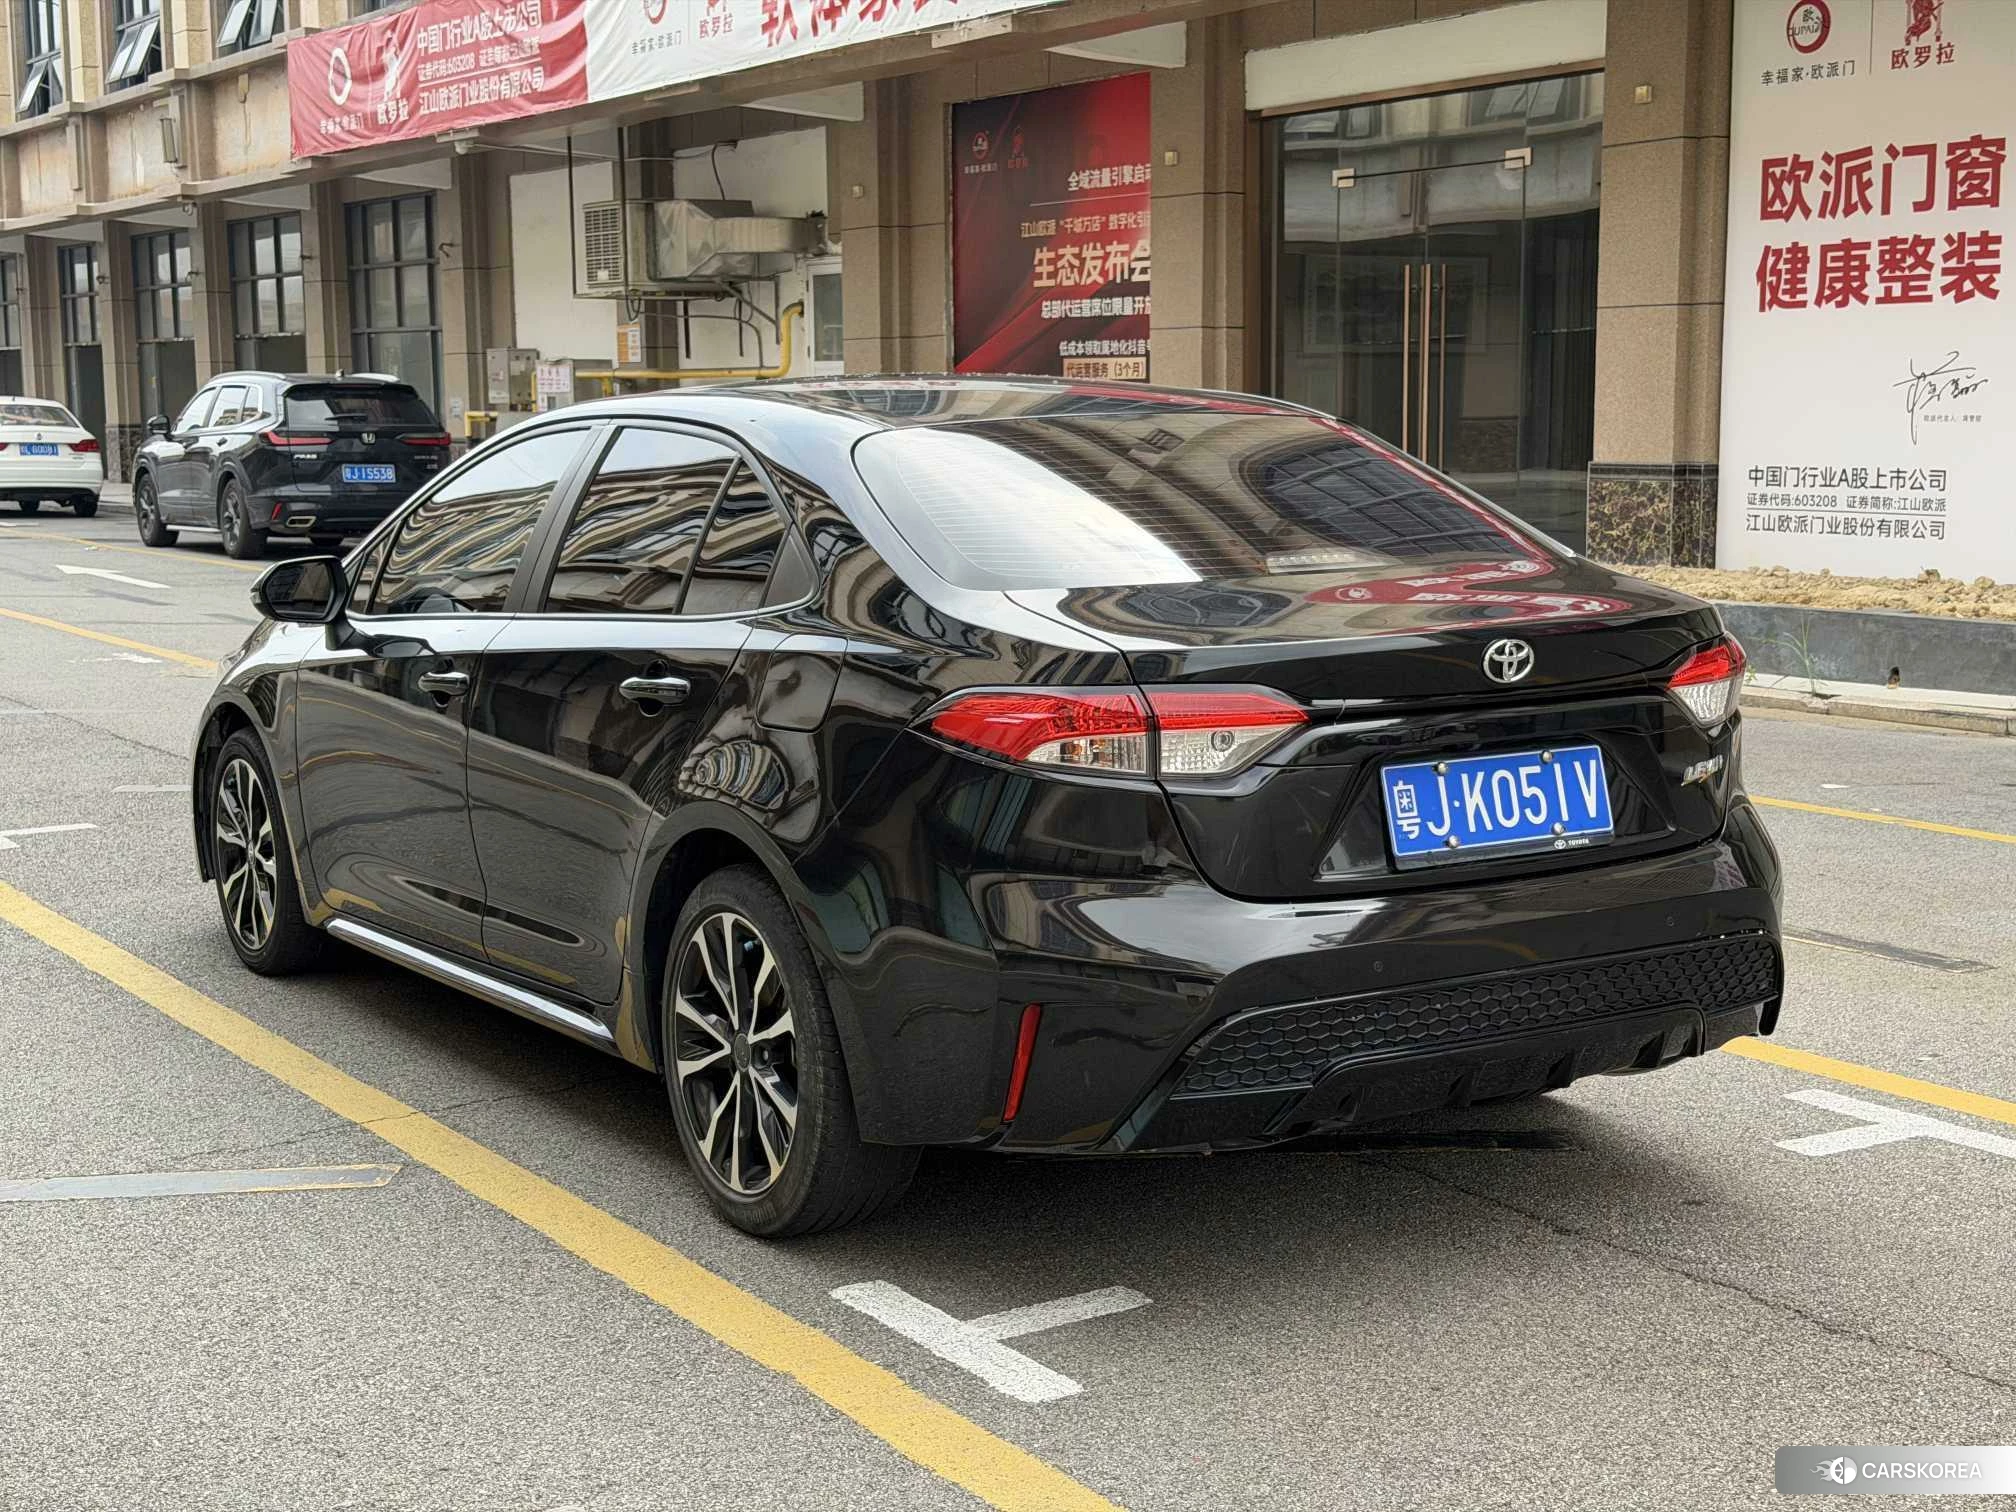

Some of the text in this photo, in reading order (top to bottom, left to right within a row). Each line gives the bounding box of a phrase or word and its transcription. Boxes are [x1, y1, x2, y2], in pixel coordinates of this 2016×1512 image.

[417, 1, 542, 56] 中国门行业A股上市公司
[1890, 42, 1955, 70] 欧罗拉
[418, 66, 545, 115] 江山欧派门业股份有限公司
[1760, 134, 2006, 223] 欧派门窗
[1032, 240, 1151, 288] 生态发布会
[1755, 230, 2002, 312] 健康整装
[1748, 465, 1947, 491] 中国门行业A股上市公司
[1746, 513, 1945, 540] 江山欧派门业股份有限公司
